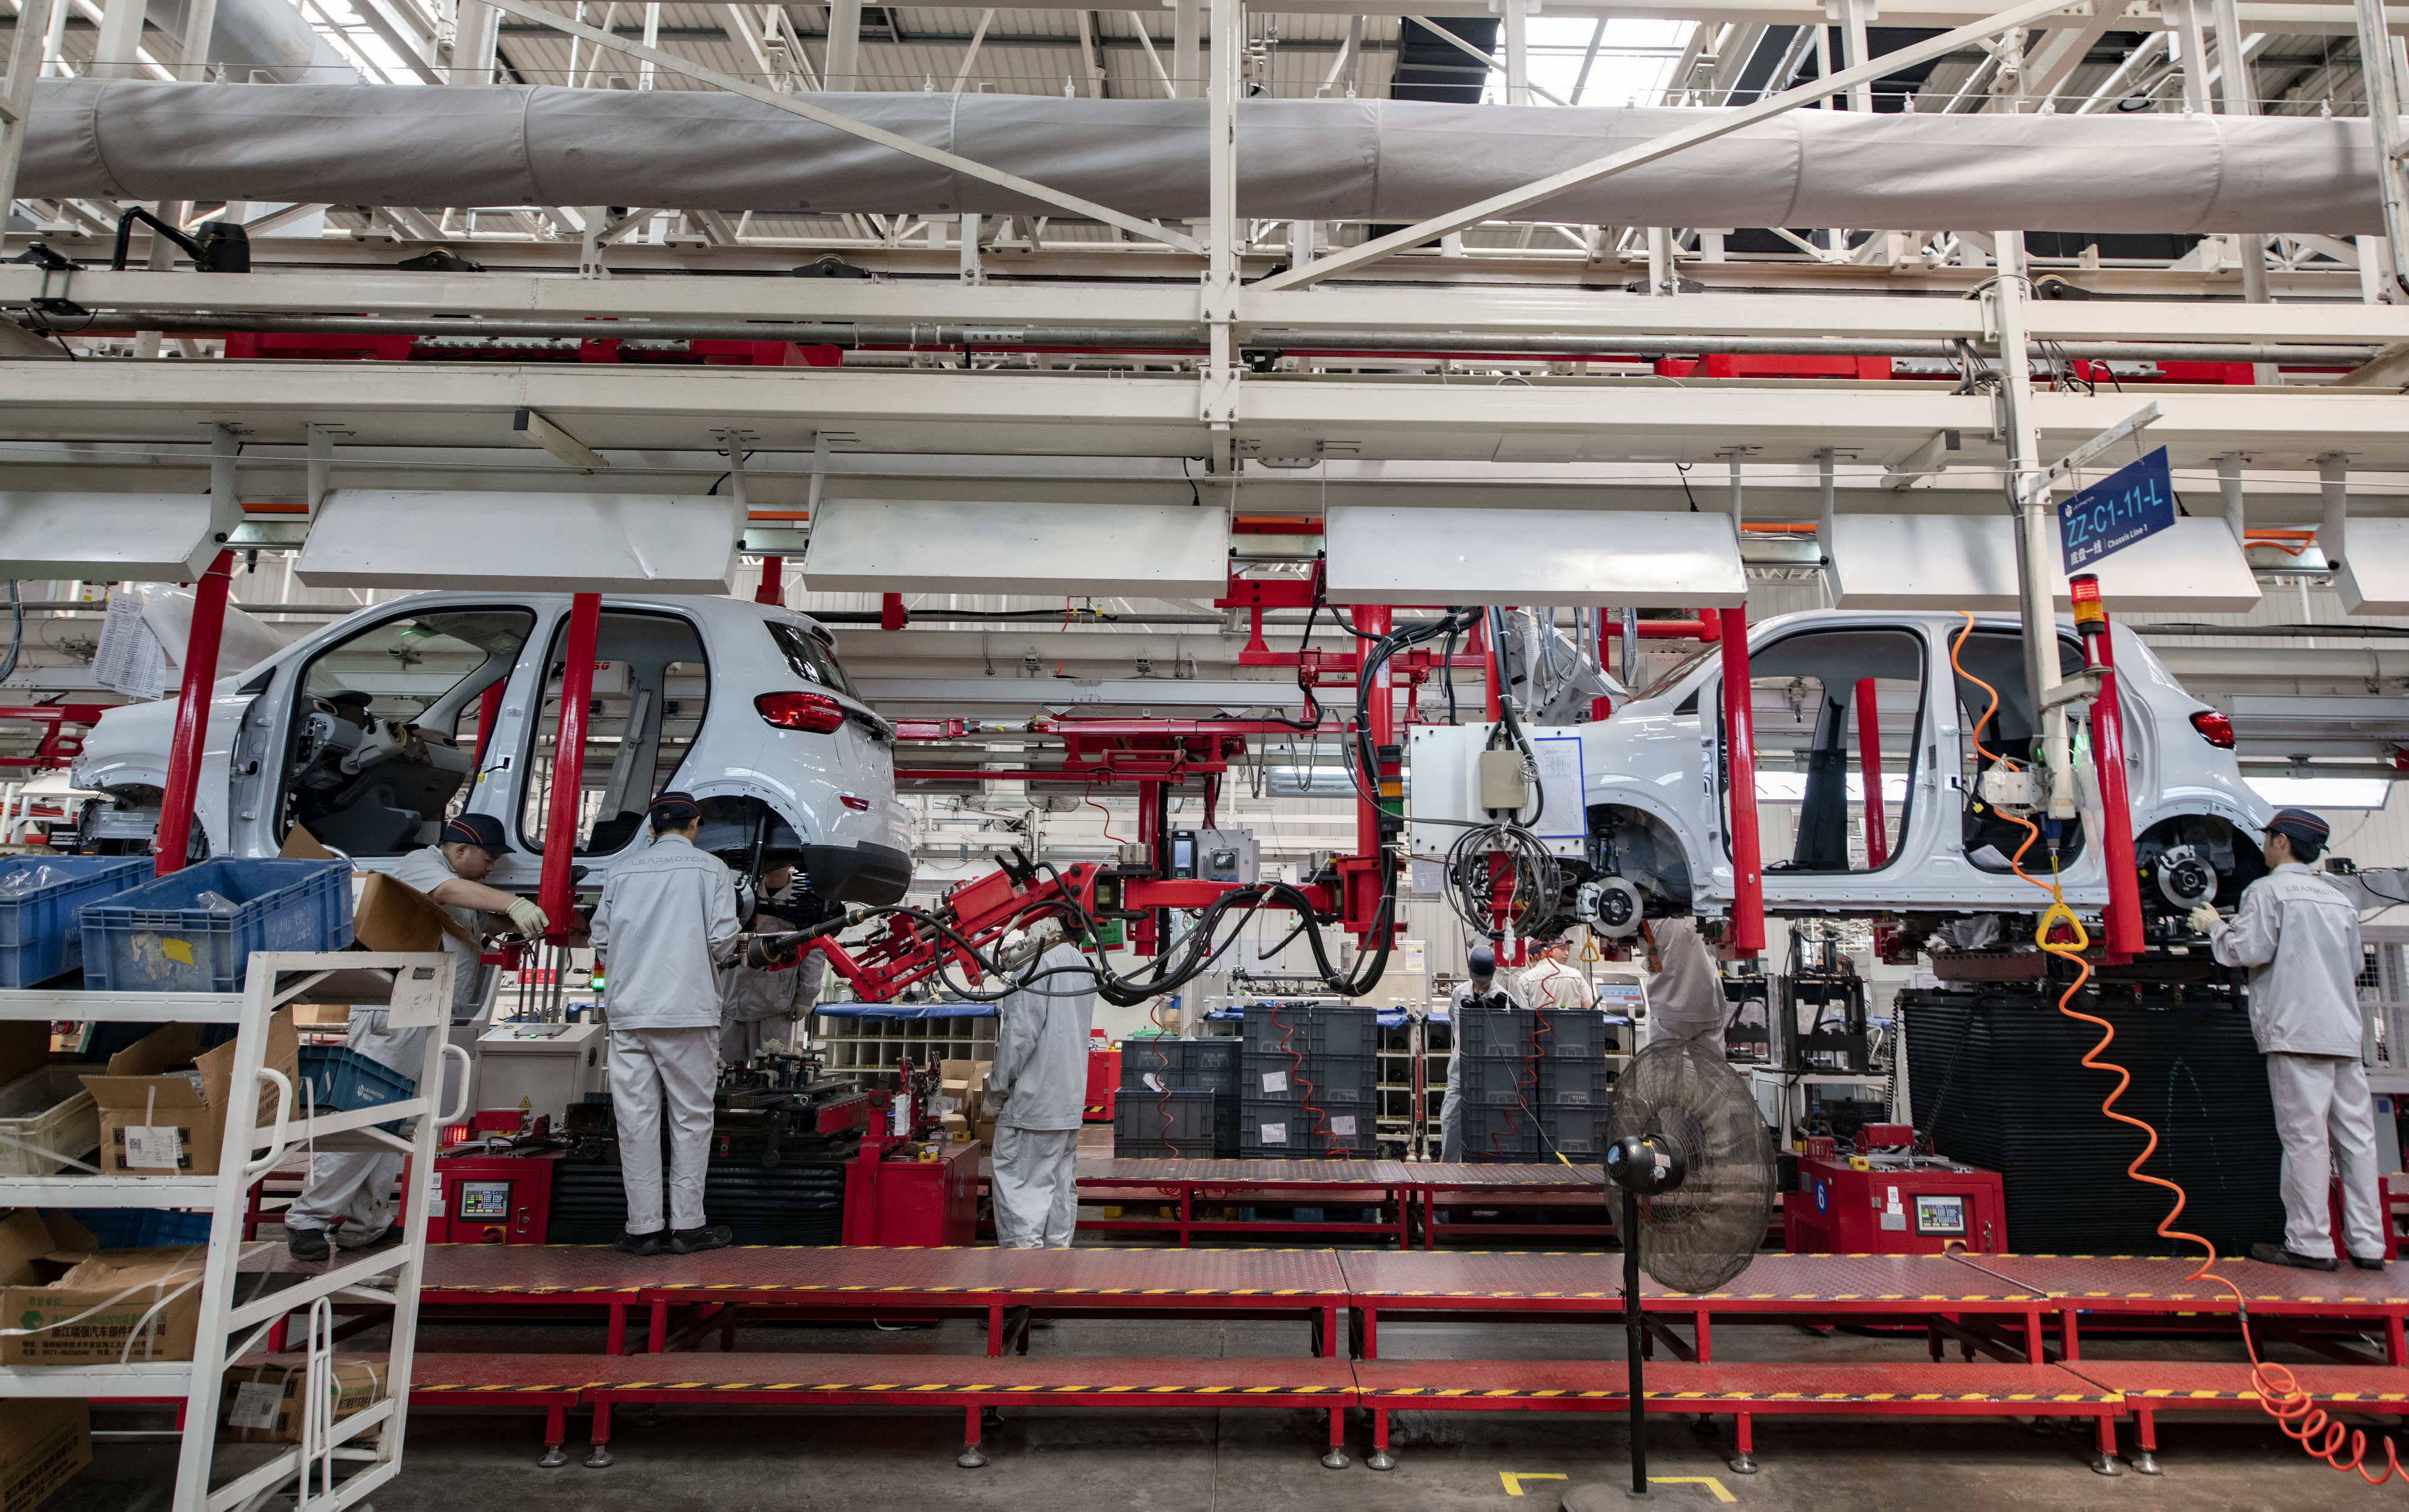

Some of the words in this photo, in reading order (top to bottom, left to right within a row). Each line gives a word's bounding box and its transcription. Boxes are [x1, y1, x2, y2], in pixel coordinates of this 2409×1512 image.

[2066, 479, 2163, 547] ZZ-C1-11-L
[2108, 533, 2130, 549] Chassis
[2130, 527, 2143, 538] Line
[2143, 523, 2148, 532] 1
[631, 856, 708, 865] LEAPMOTOR
[1818, 1184, 1825, 1210] 6
[52, 1324, 166, 1337] 浙江瑞强汽车部件有限司
